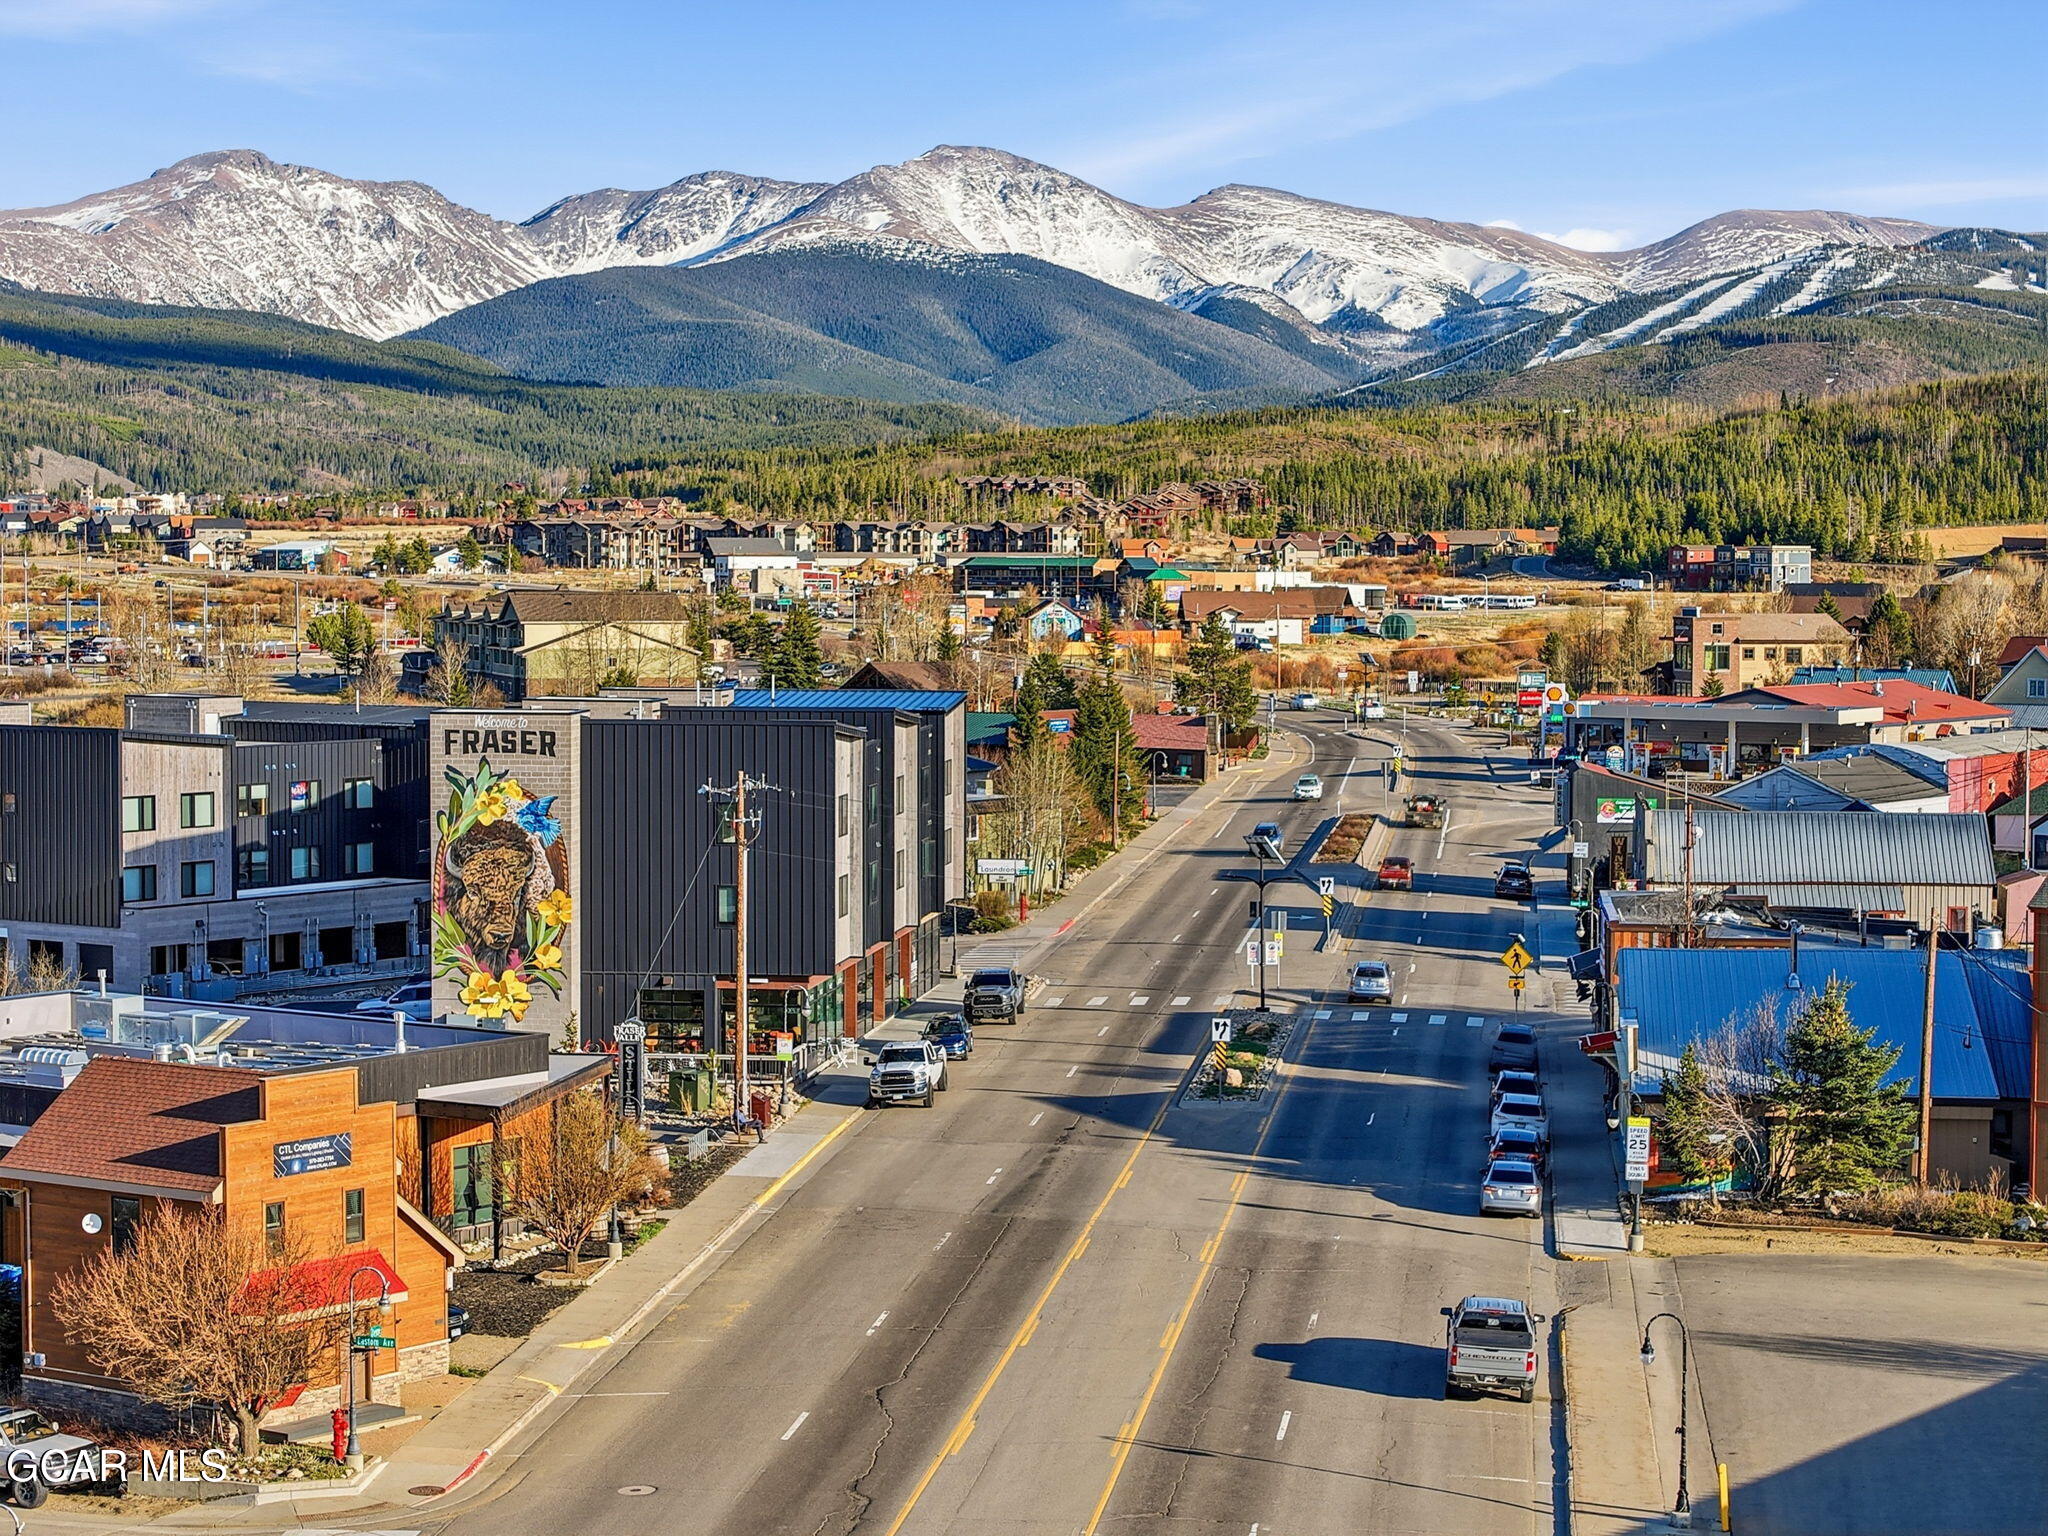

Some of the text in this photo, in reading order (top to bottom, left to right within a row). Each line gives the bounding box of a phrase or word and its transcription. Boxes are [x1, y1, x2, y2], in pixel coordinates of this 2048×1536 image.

[474, 714, 528, 728] Welcome to
[444, 729, 556, 757] FRASER
[613, 1025, 646, 1035] FRASER
[614, 1033, 646, 1042] VALLEY
[279, 1145, 293, 1154] CTL
[294, 1139, 329, 1151] Companies
[1629, 1140, 1647, 1149] 25
[1461, 1352, 1521, 1360] CHEVROLET
